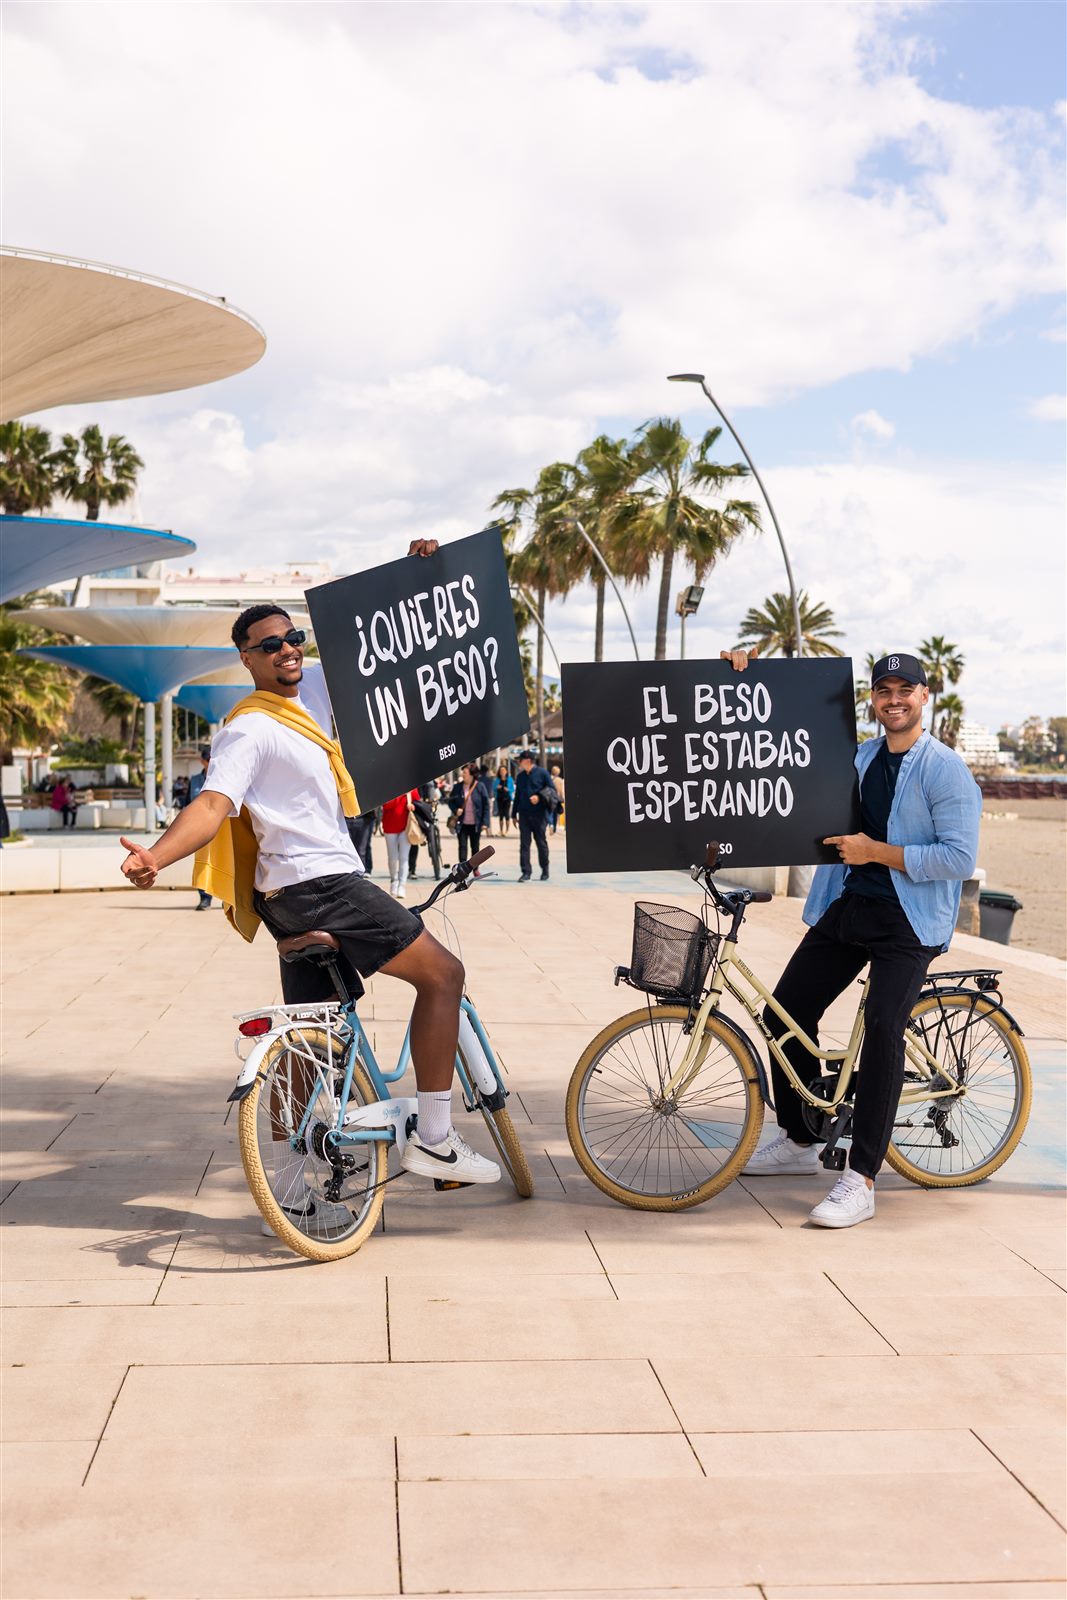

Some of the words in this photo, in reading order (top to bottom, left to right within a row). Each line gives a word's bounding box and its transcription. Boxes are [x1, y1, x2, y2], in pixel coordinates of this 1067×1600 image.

[888, 656, 900, 671] B
[365, 677, 409, 747] UN
[416, 636, 500, 722] BESO?
[642, 685, 678, 728] EL
[694, 681, 772, 726] BESO
[438, 743, 457, 761] BESO
[606, 734, 669, 776] QUE
[684, 728, 811, 774] ESTABAS
[627, 775, 794, 824] ESPERANDO
